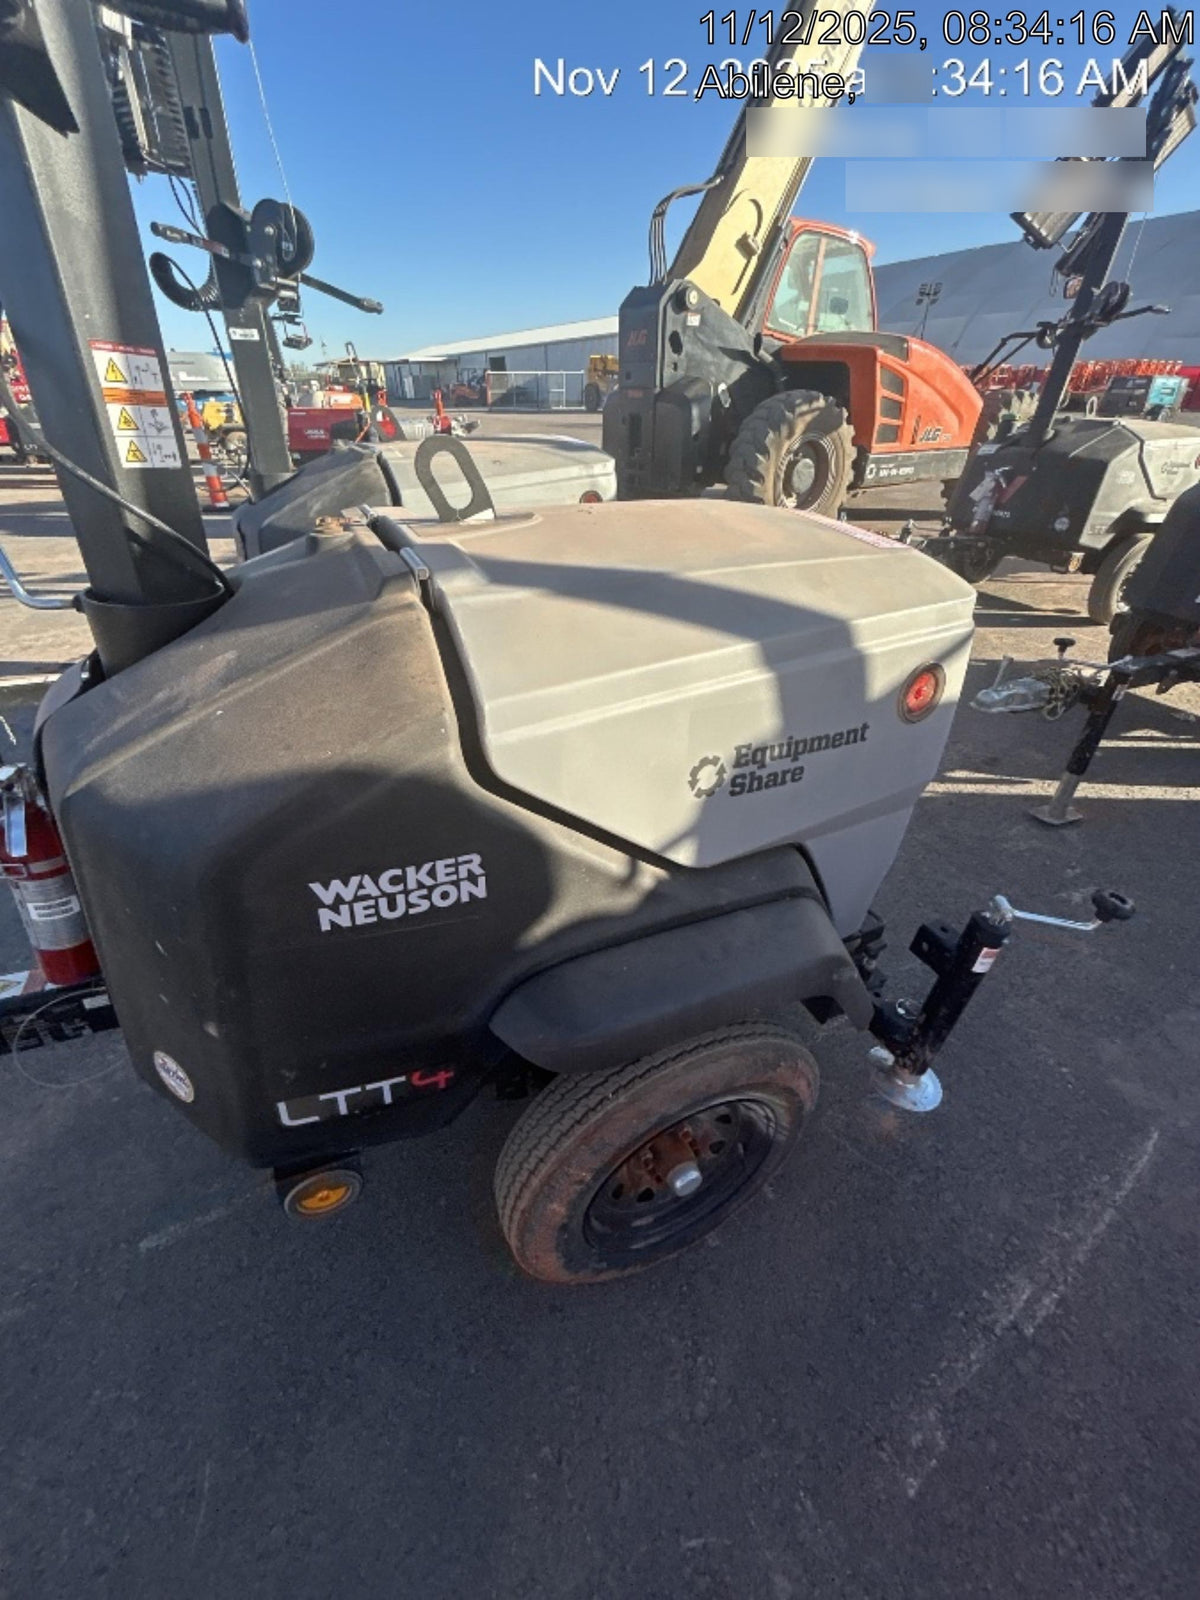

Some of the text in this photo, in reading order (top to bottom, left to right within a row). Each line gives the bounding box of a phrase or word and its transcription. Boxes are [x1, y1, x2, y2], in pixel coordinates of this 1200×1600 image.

[732, 722, 870, 770] Equipment
[729, 765, 805, 797] Share
[308, 853, 486, 905] WACKER
[318, 876, 488, 932] NEUSON
